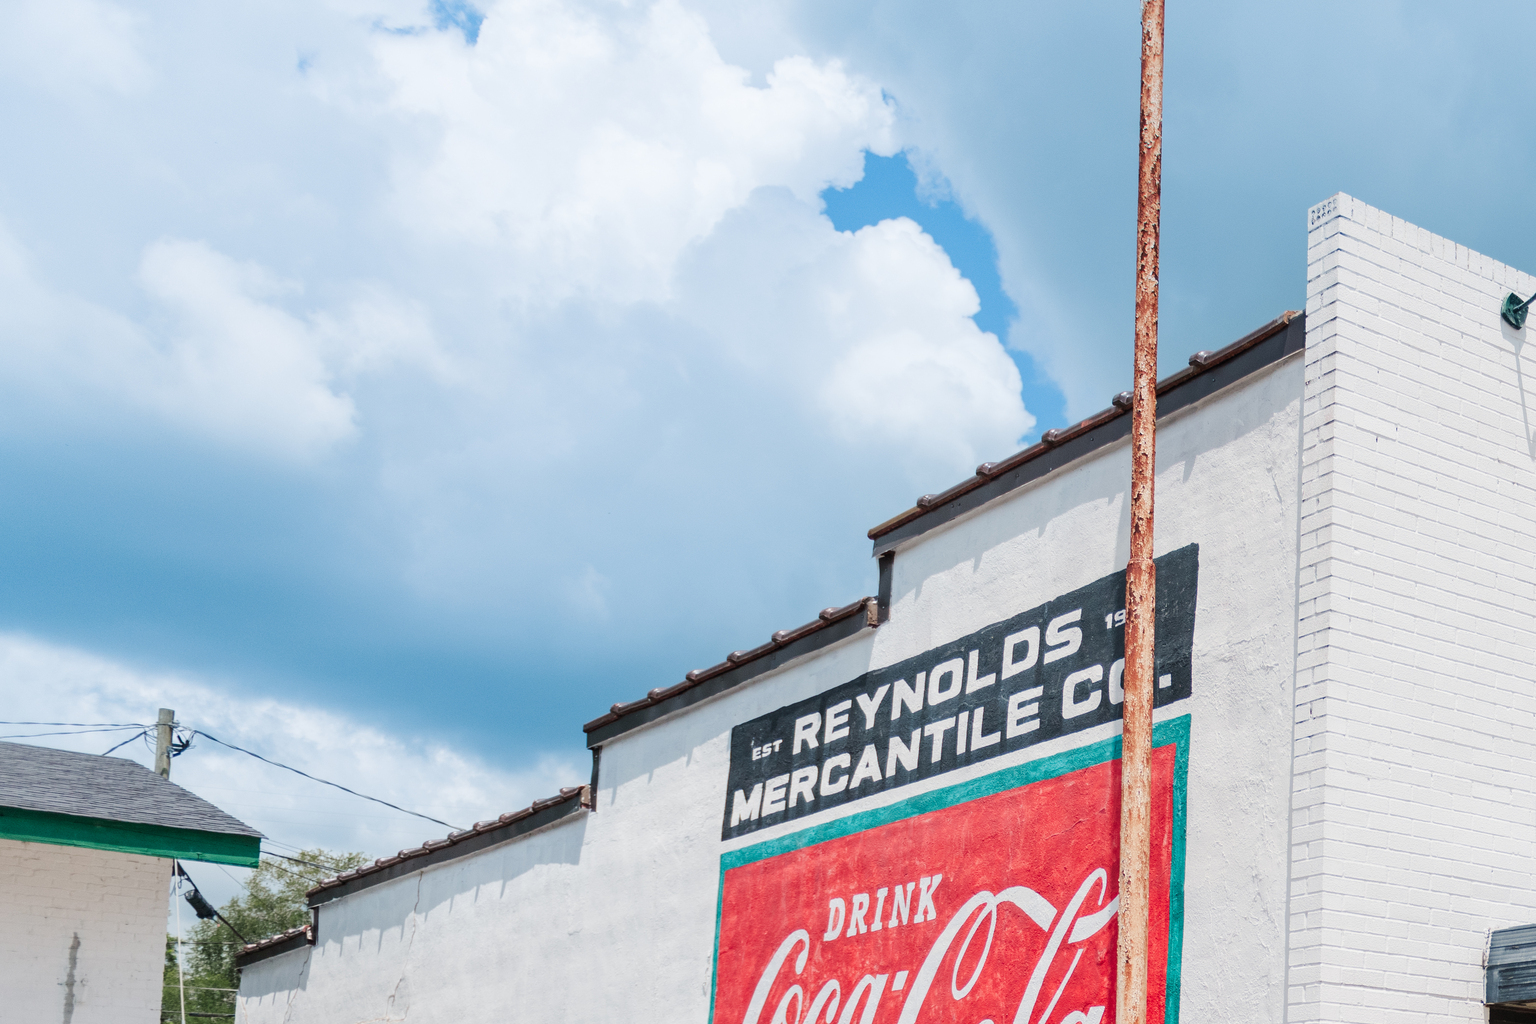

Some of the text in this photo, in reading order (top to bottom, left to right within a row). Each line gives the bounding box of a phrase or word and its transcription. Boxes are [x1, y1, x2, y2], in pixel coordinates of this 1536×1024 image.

[752, 608, 1126, 761] EST REYNOLDS 19
[730, 685, 1044, 828] MERCANTILE
[824, 873, 943, 942] DRINK
